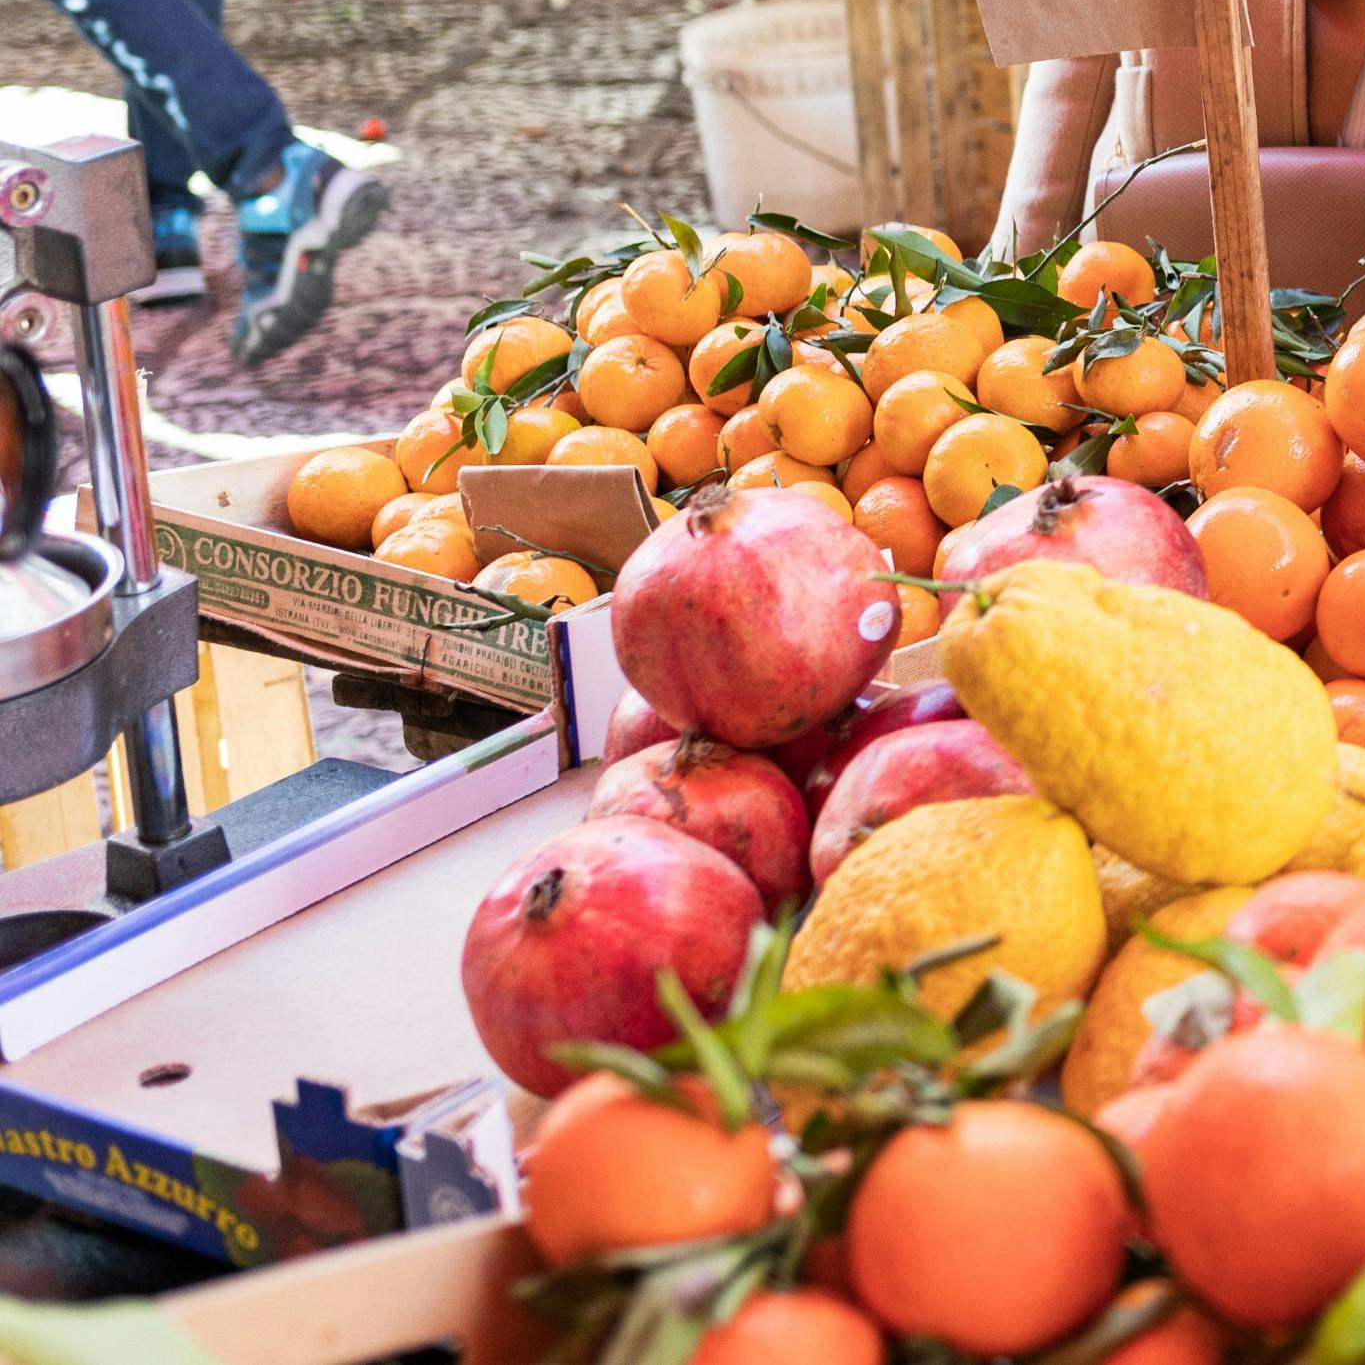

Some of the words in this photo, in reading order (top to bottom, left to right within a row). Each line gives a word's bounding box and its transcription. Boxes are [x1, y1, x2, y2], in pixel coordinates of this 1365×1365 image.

[194, 537, 363, 604] CONSORZIO
[373, 582, 487, 640] FUNGHI
[345, 610, 367, 626] DELLA
[441, 653, 495, 679] AGARICUS
[0, 1129, 97, 1170] astro
[104, 1142, 260, 1251] Azzurro
